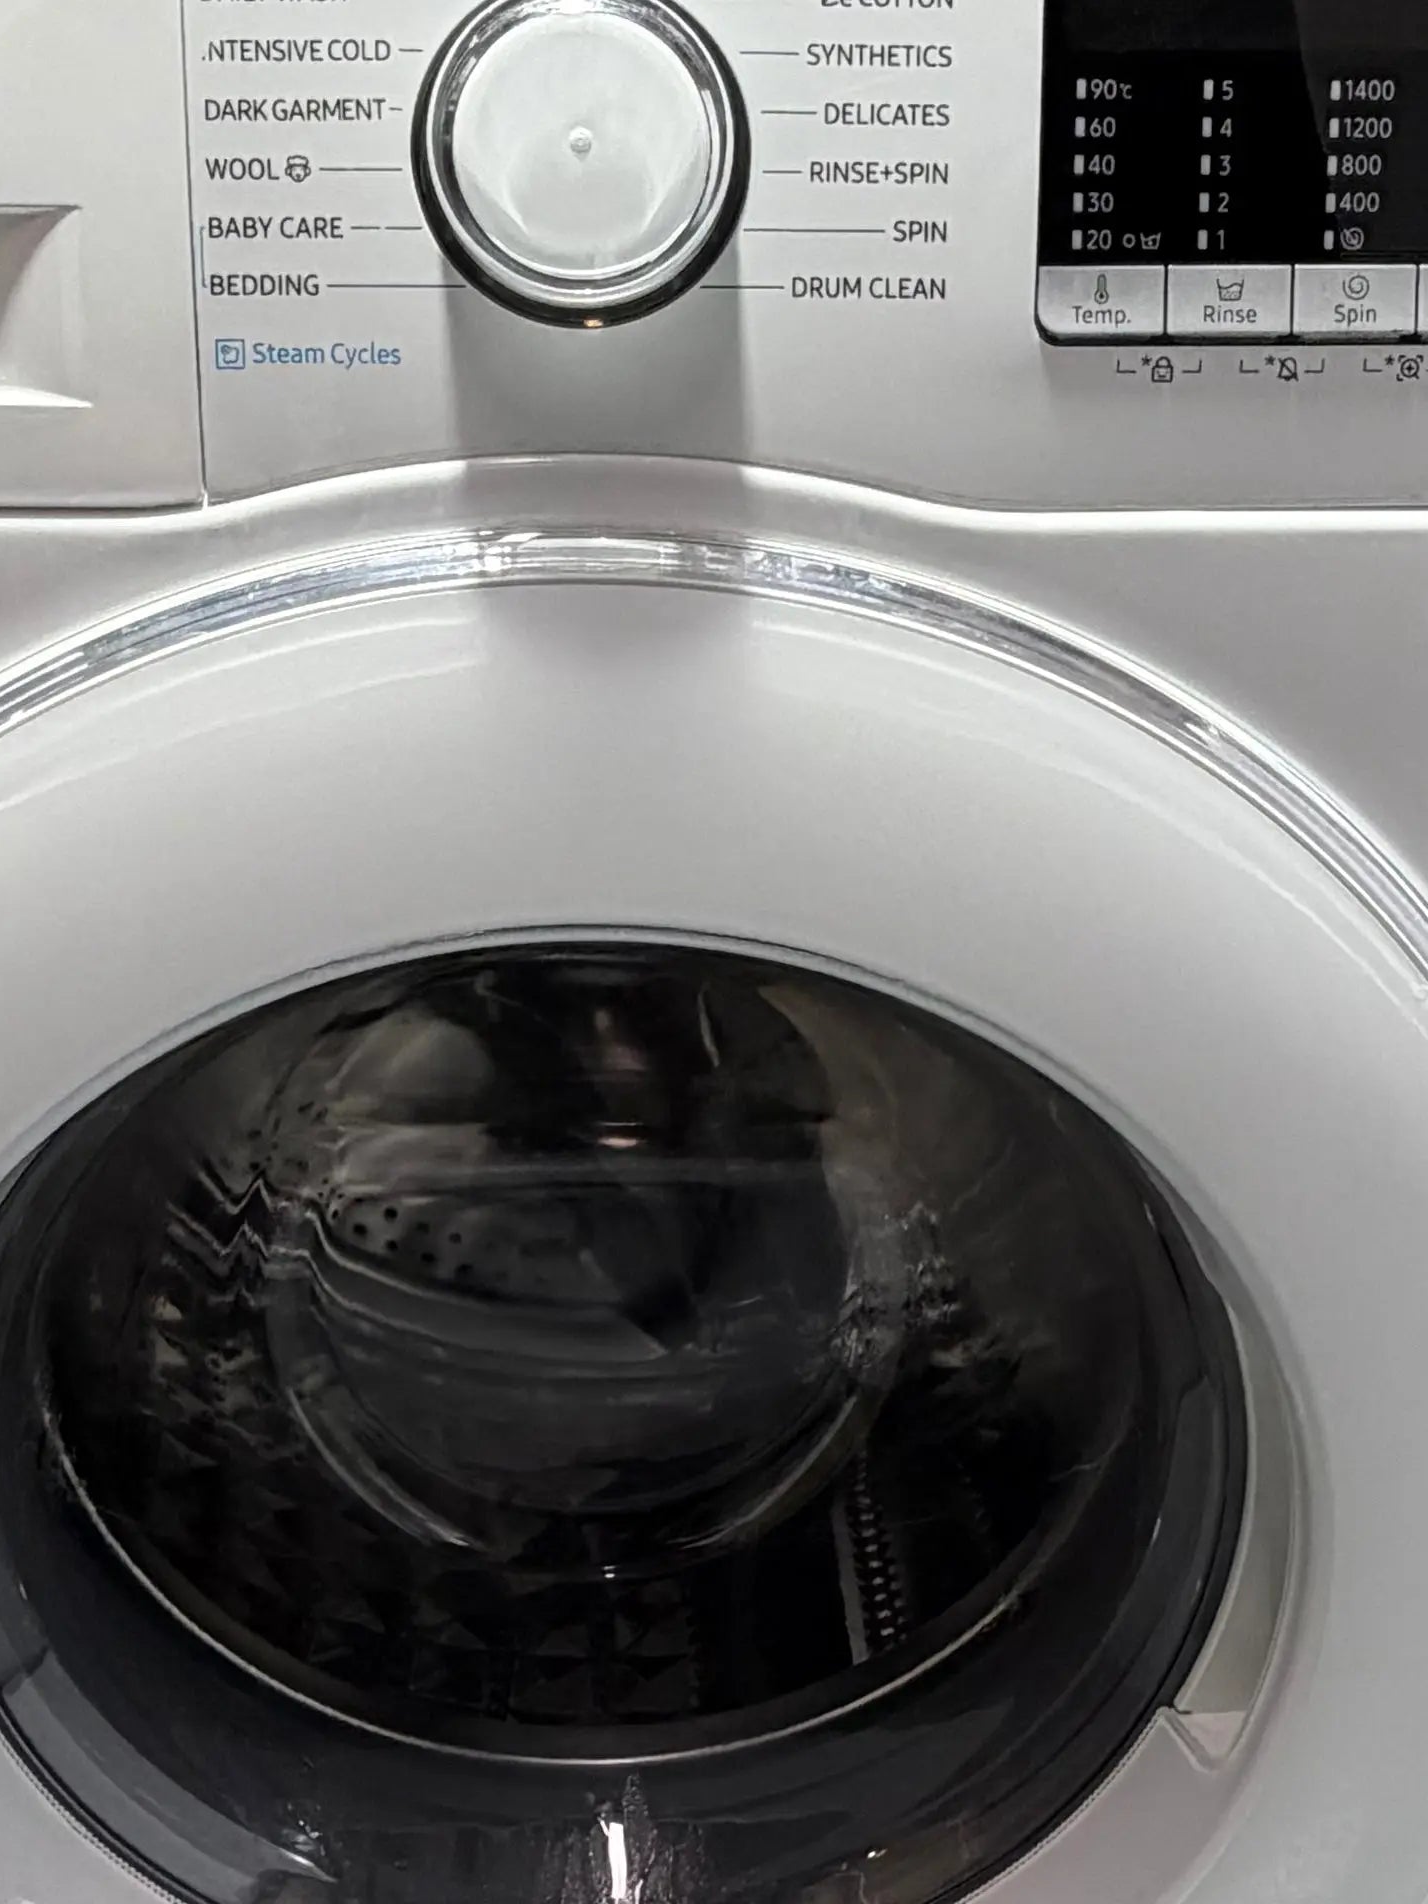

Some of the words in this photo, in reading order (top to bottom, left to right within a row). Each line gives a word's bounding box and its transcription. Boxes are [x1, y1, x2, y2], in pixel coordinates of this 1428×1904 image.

[201, 40, 323, 62] NTENSIVE
[327, 39, 391, 62] COLD
[806, 43, 953, 68] SYNTHETICS
[1221, 79, 1234, 101] 5
[1345, 79, 1396, 102] 1400
[204, 99, 269, 122] DARK
[272, 98, 386, 122] GARMENT
[824, 102, 951, 127] DELICATES
[1089, 116, 1116, 138] 60
[1219, 117, 1232, 138] 4
[1343, 117, 1393, 139] 1200
[205, 158, 280, 181] WOOL
[810, 161, 949, 185] RINSE+SPIN
[1088, 154, 1116, 176] 40
[1219, 154, 1232, 176] 3
[1341, 154, 1382, 176] 800
[1087, 192, 1114, 213] 30
[1217, 192, 1230, 213] 2
[1339, 192, 1380, 213] 400
[208, 216, 273, 239] BABY
[279, 216, 344, 239] CARE
[893, 220, 948, 243] SPIN
[1086, 229, 1113, 250] 20
[1217, 229, 1226, 250] 1
[209, 274, 320, 297] BEDDING
[792, 276, 862, 300] DRUM
[869, 277, 946, 300] CLEAN
[1072, 305, 1132, 328] Temp.
[1203, 304, 1258, 324] Rinse
[1334, 304, 1378, 328] Spin
[252, 342, 325, 365] Steam
[330, 340, 402, 371] Cycles
